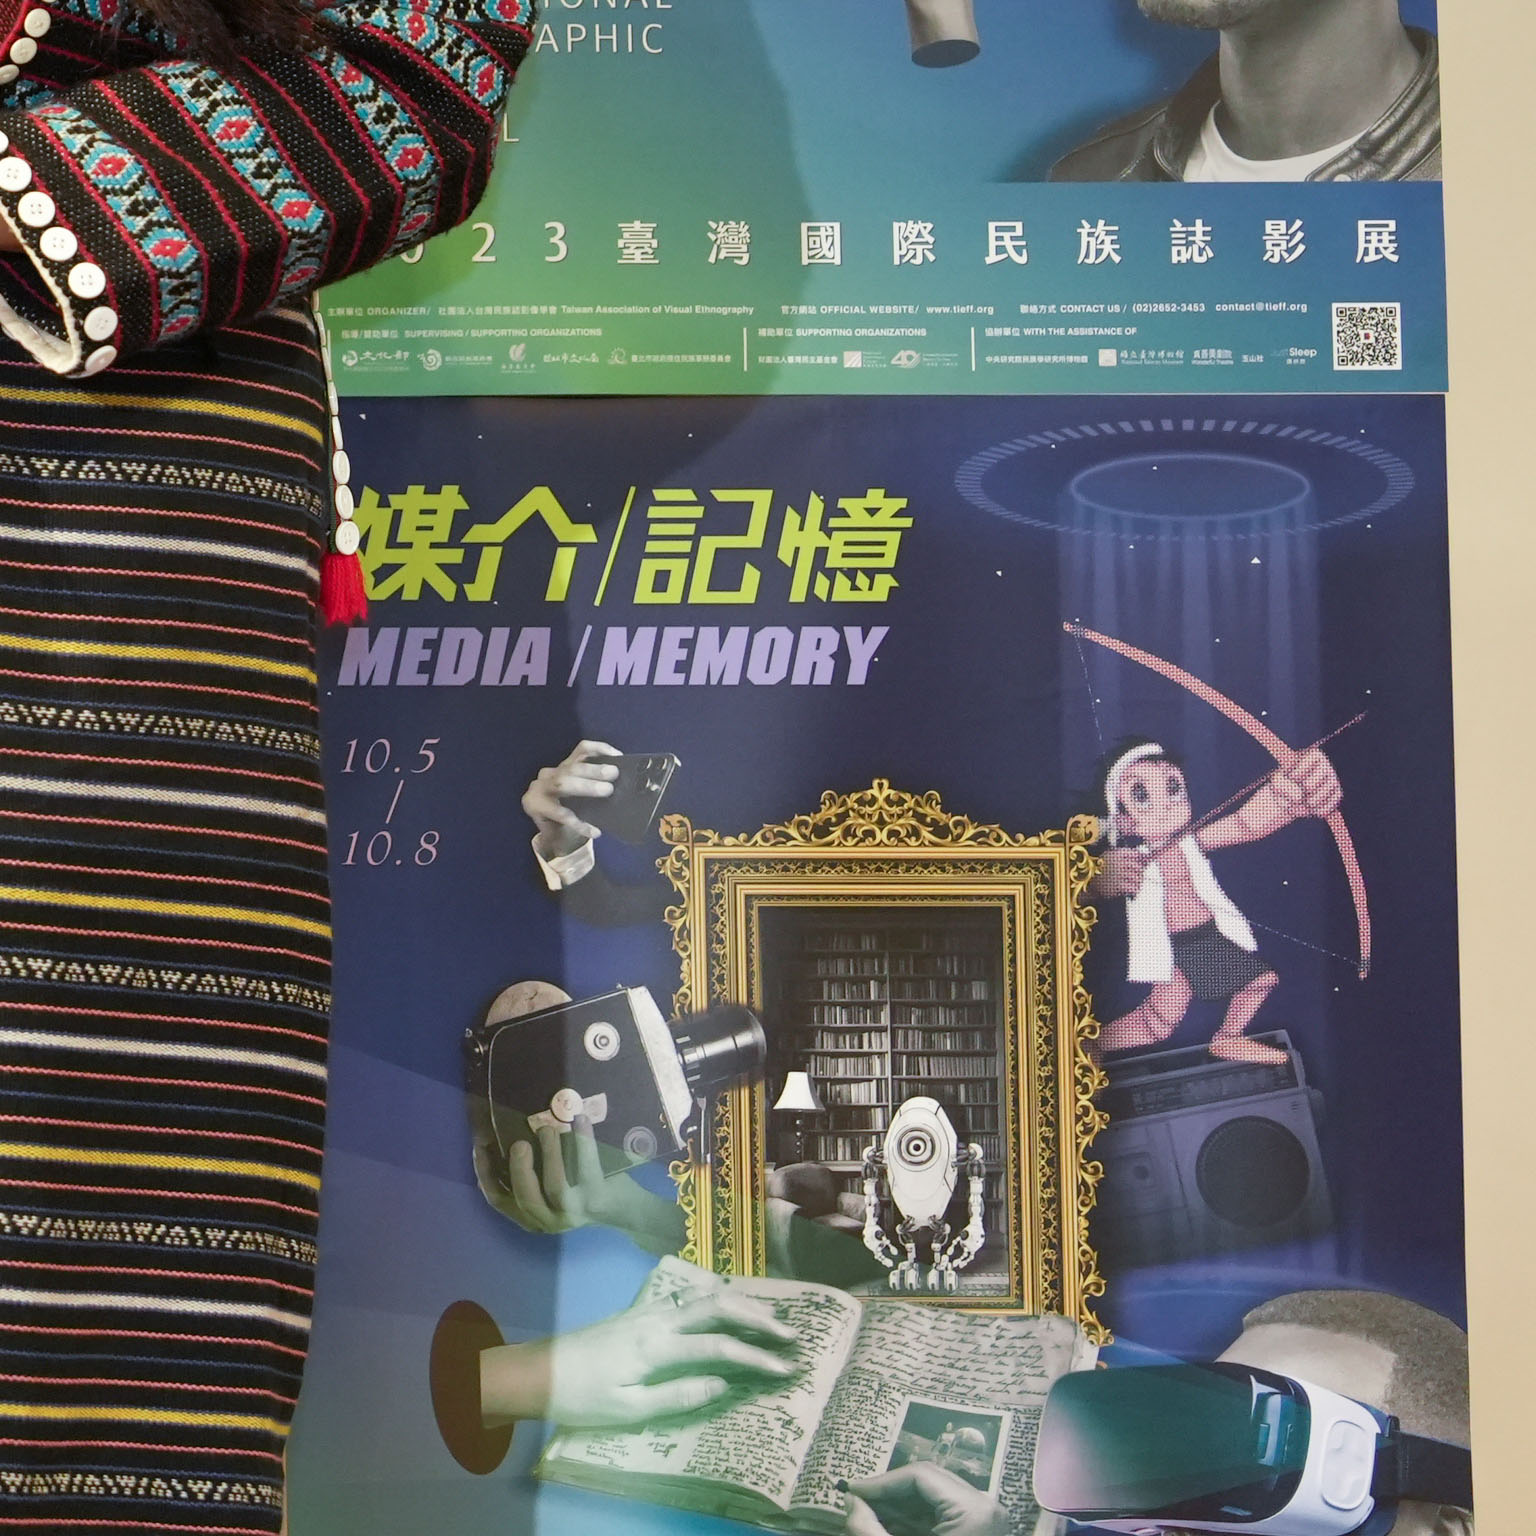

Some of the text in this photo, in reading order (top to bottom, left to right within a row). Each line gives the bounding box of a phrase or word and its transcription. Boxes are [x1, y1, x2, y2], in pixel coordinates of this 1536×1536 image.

[532, 23, 663, 54] APHIC
[561, 305, 592, 314] Taiwan
[595, 305, 650, 314] Association
[652, 305, 663, 314] of
[664, 305, 693, 314] Visual
[695, 305, 754, 316] Ethnography
[820, 305, 866, 314] OFFICIAL
[926, 305, 994, 316] www.tieff.org
[1060, 304, 1104, 313] CONTACT
[1107, 304, 1121, 313] US
[1132, 303, 1205, 314] (02)2652-3453
[1215, 302, 1308, 314] contact@tieff.org
[470, 329, 528, 338] SUPPORTING
[530, 328, 602, 337] ORGANIZATIONS
[796, 327, 852, 337] SUPPORTING
[854, 327, 927, 337] ORGANIZATIONS
[1023, 327, 1046, 336] WITH
[1048, 327, 1065, 336] THE
[1067, 327, 1123, 336] ASSISTANCE
[1124, 327, 1137, 336] OF
[337, 626, 553, 688] MEDIA
[595, 625, 890, 687] MEMORY
[340, 737, 441, 774] 10.5
[340, 831, 440, 867] 10.8
